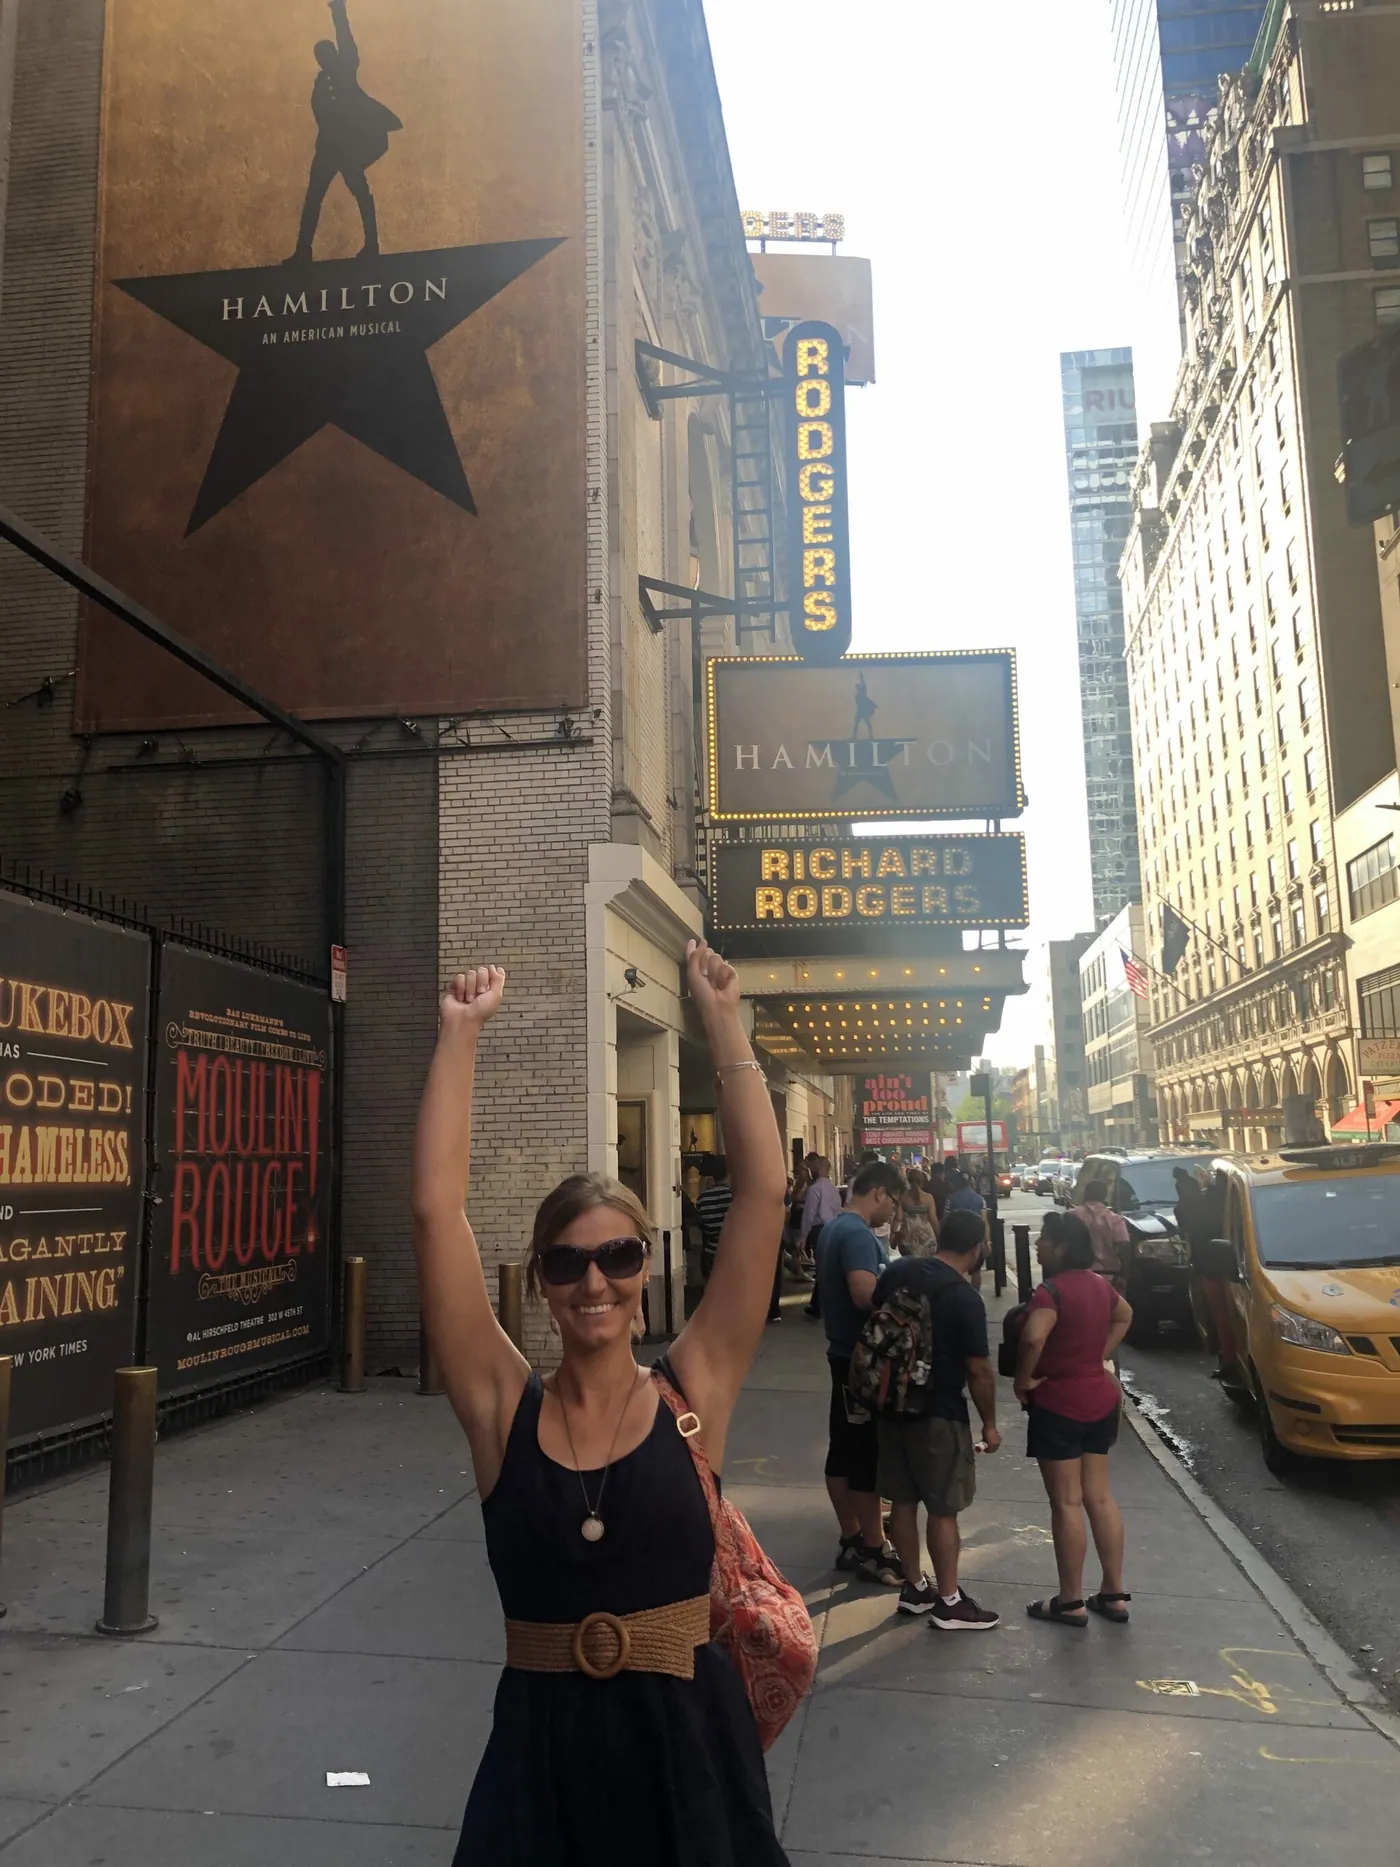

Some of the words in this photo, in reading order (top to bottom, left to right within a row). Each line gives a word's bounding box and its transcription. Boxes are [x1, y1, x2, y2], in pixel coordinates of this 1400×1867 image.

[222, 278, 448, 320] HAMILTON
[262, 333, 277, 344] AN
[284, 327, 344, 343] AMERICAN
[350, 321, 401, 336] MUSICAL
[1084, 388, 1135, 412] RIU
[796, 338, 837, 631] RODGERS
[734, 738, 995, 770] HAMILTON
[761, 847, 973, 881] RICHARD
[755, 884, 982, 919] RODGERS
[6, 1074, 132, 1113] ODED!
[175, 1050, 303, 1156] MOULIN
[863, 1095, 928, 1116] proud
[863, 1116, 877, 1124] THE
[879, 1115, 929, 1124] TEMPTATIONS
[193, 1332, 201, 1341] AL
[202, 1322, 239, 1339] HIRSCHFELD
[240, 1315, 264, 1330] THEATRE
[28, 1346, 56, 1364] YORK
[60, 1340, 87, 1357] TIMES
